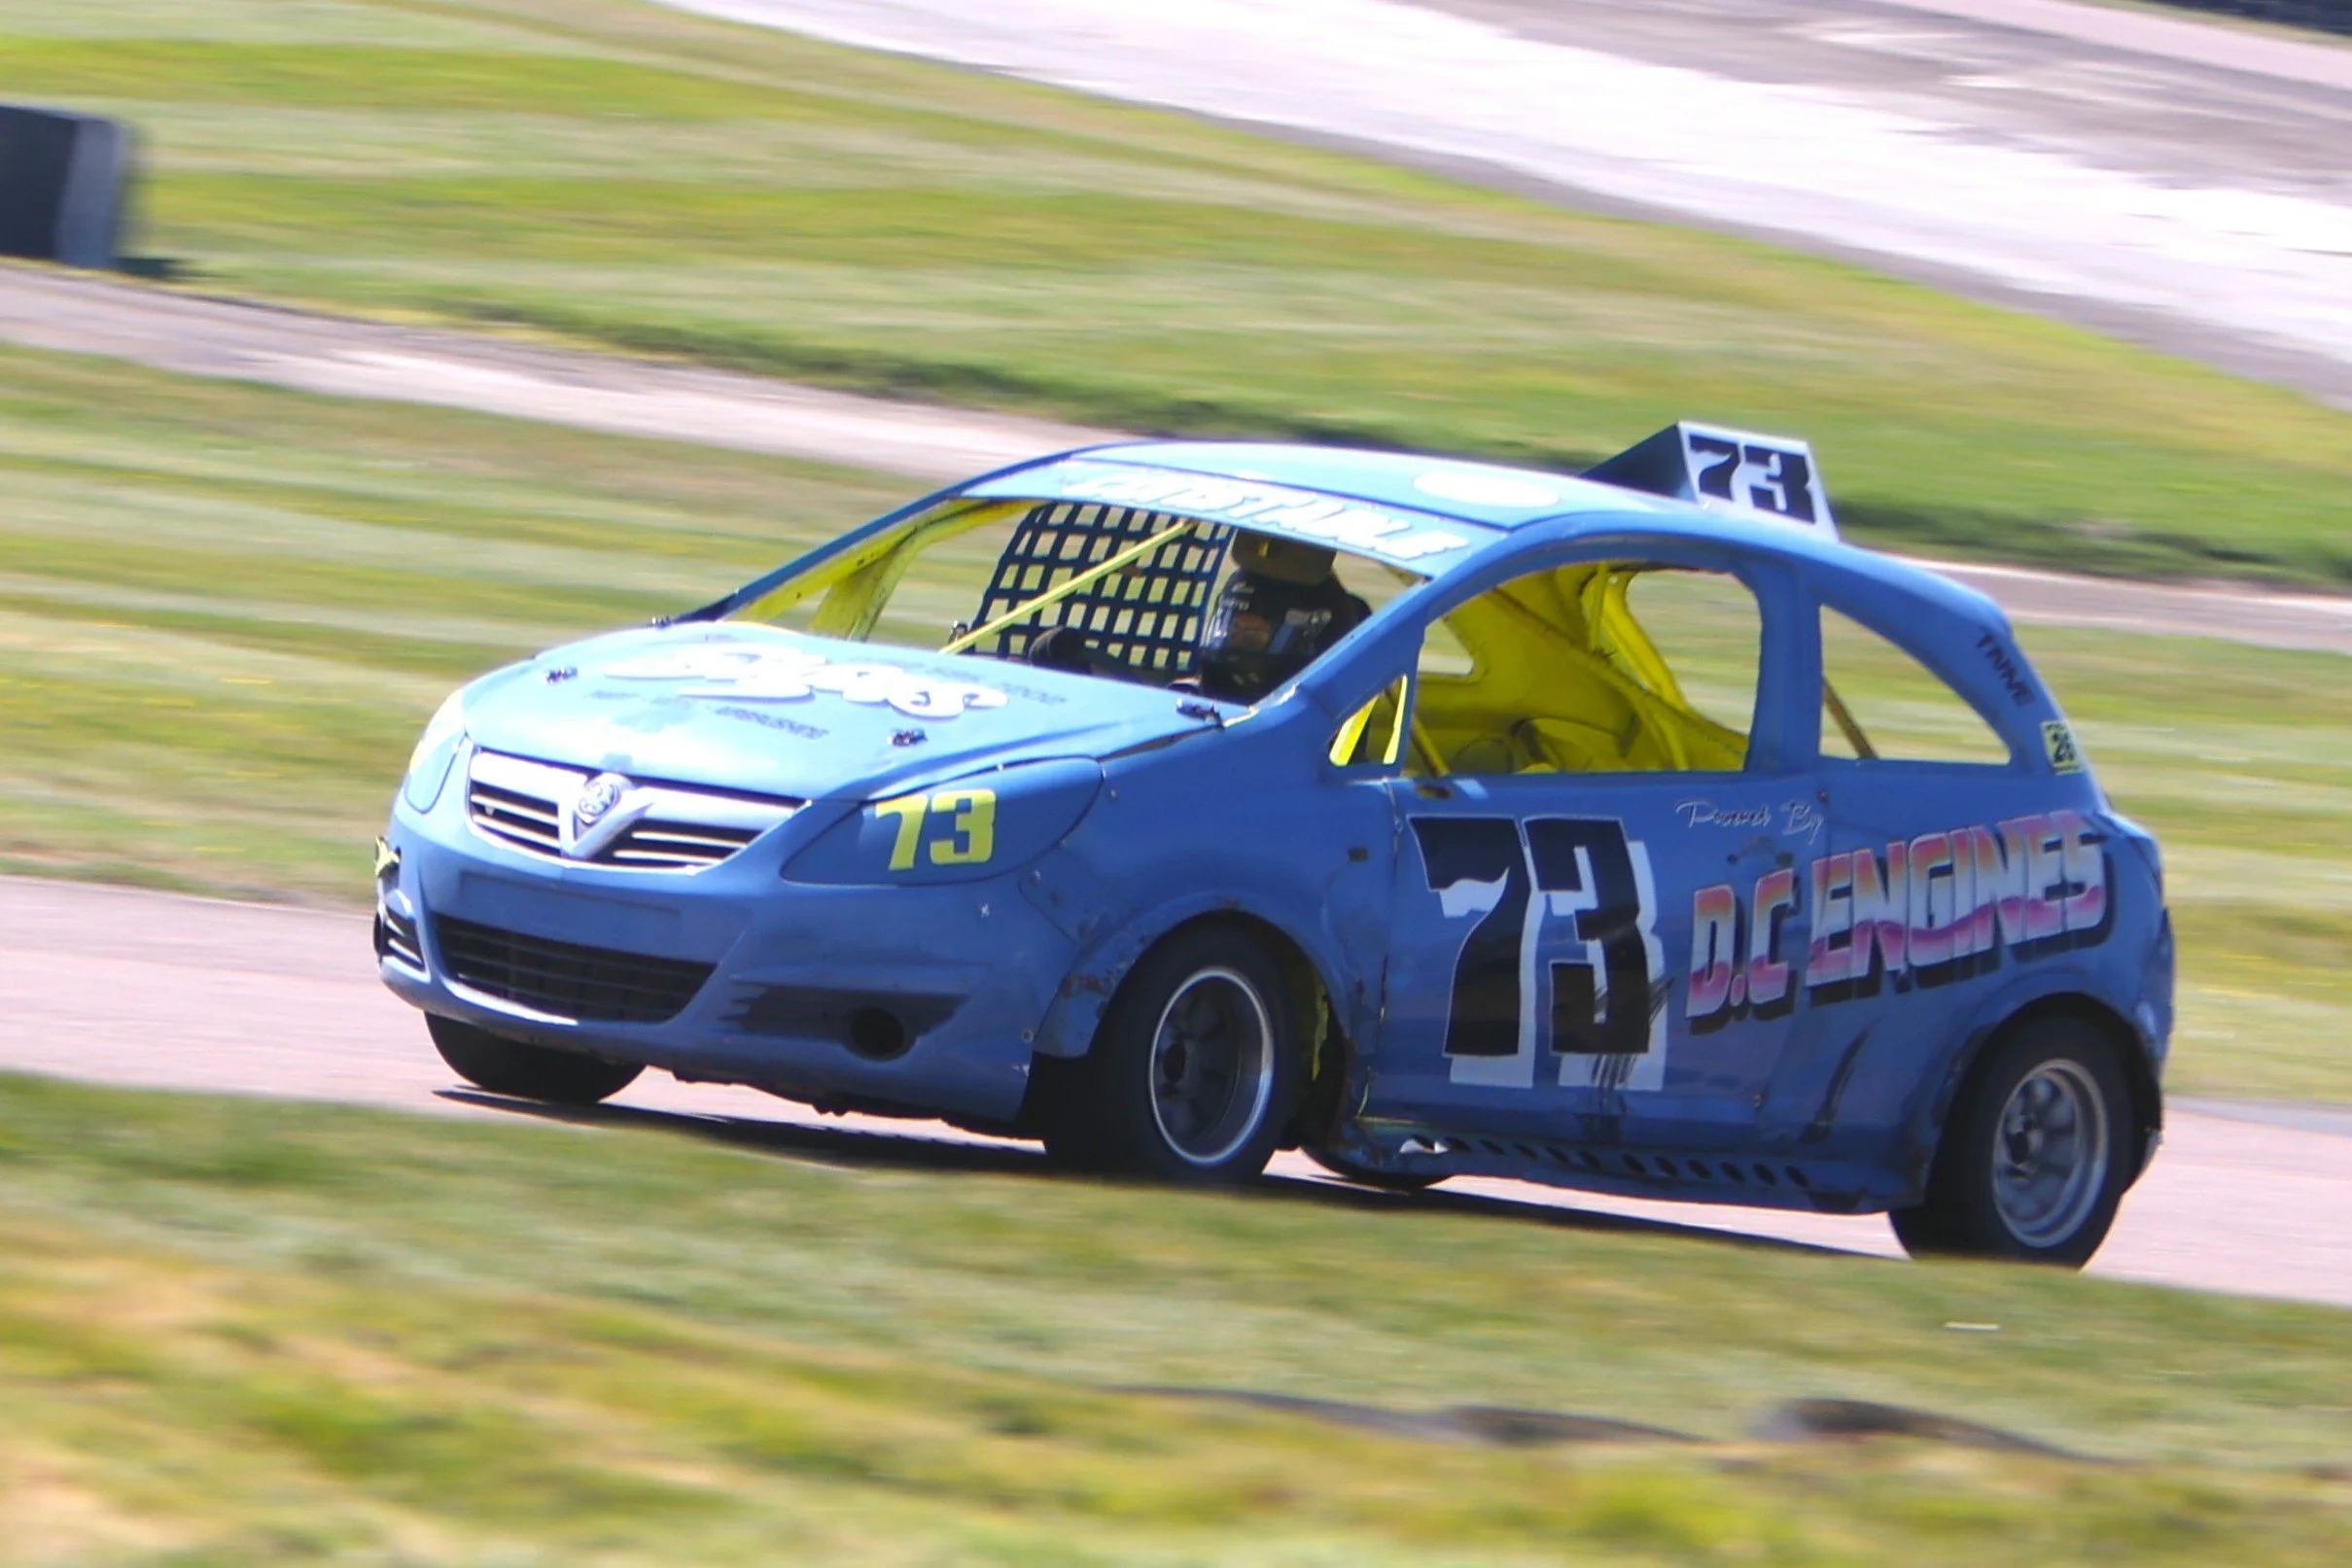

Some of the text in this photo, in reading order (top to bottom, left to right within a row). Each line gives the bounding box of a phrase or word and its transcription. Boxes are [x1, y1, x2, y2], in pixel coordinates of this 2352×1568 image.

[1688, 434, 1816, 525] 73
[875, 787, 997, 871] 73
[1781, 800, 1824, 846] By
[1406, 815, 1663, 1077] 73
[1685, 809, 2112, 1023] D.C ENGINES
